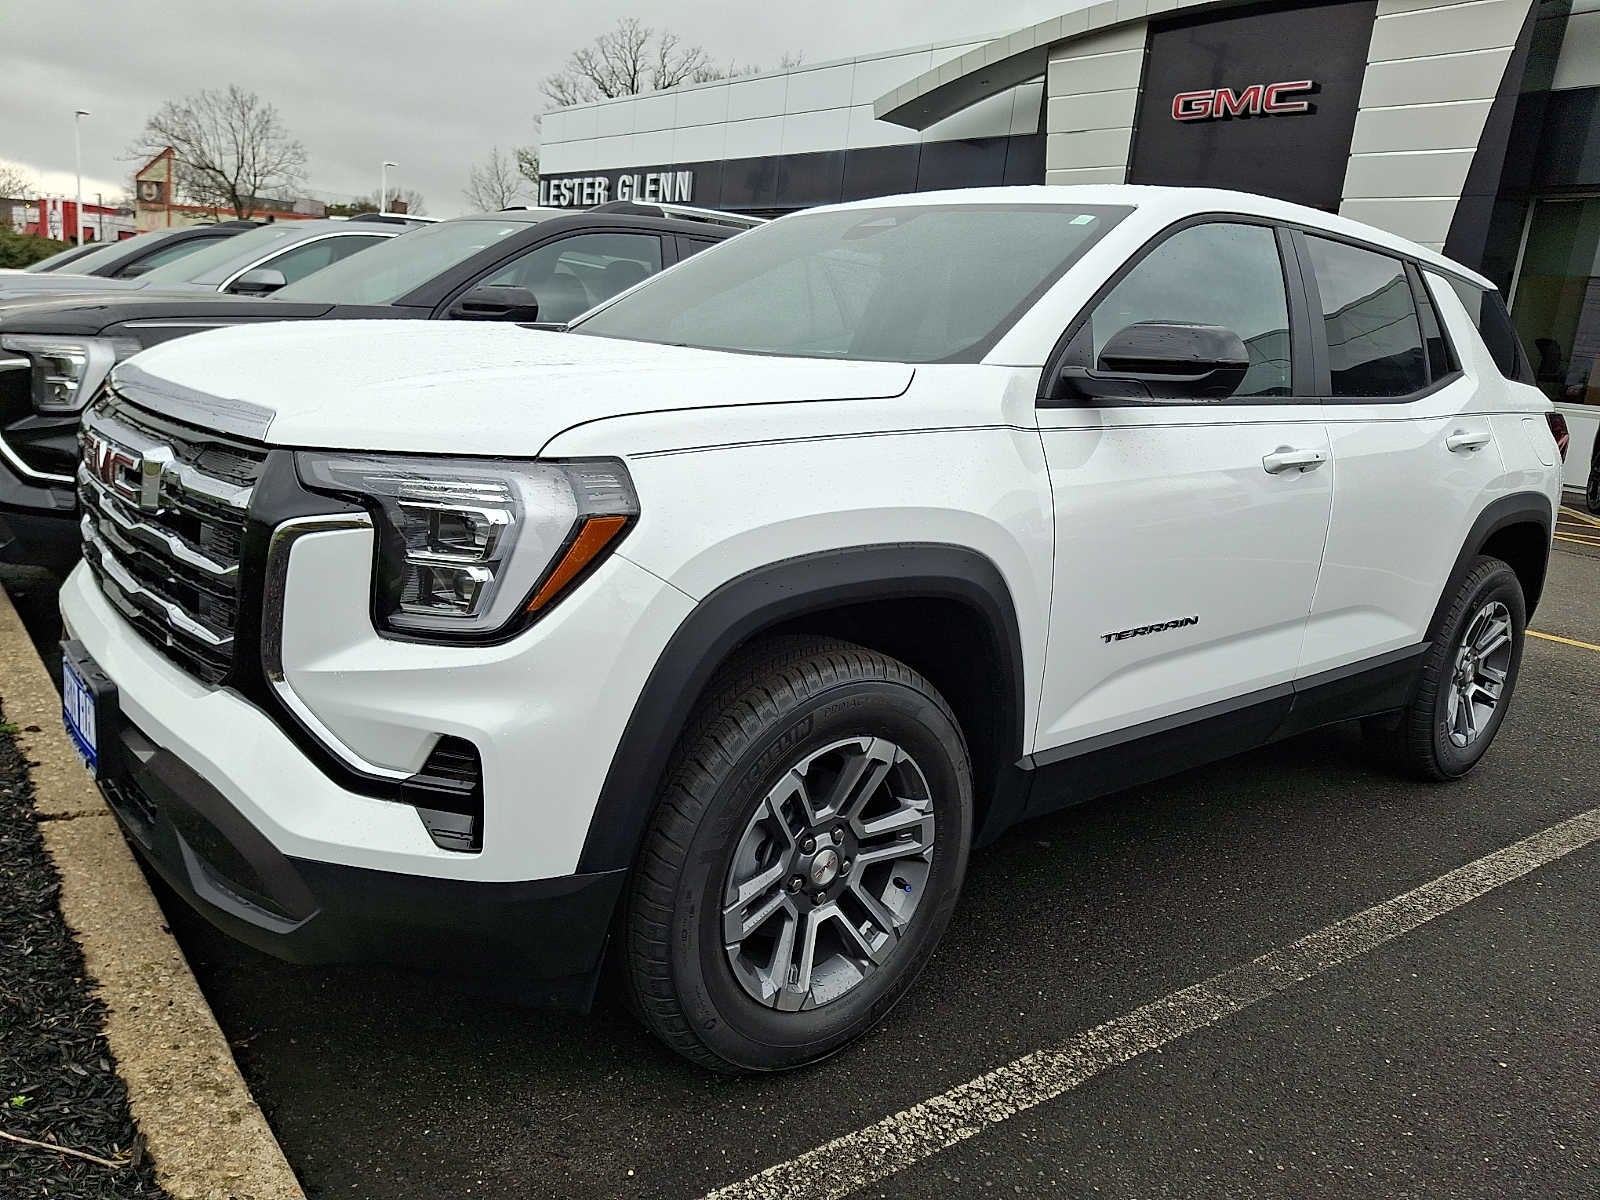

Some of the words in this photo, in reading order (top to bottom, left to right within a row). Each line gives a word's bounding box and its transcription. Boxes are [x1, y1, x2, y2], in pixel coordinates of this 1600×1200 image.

[1171, 80, 1313, 121] GMC
[539, 177, 608, 207] LESTER
[617, 170, 693, 202] GLENN
[1100, 615, 1199, 643] TERRAIN
